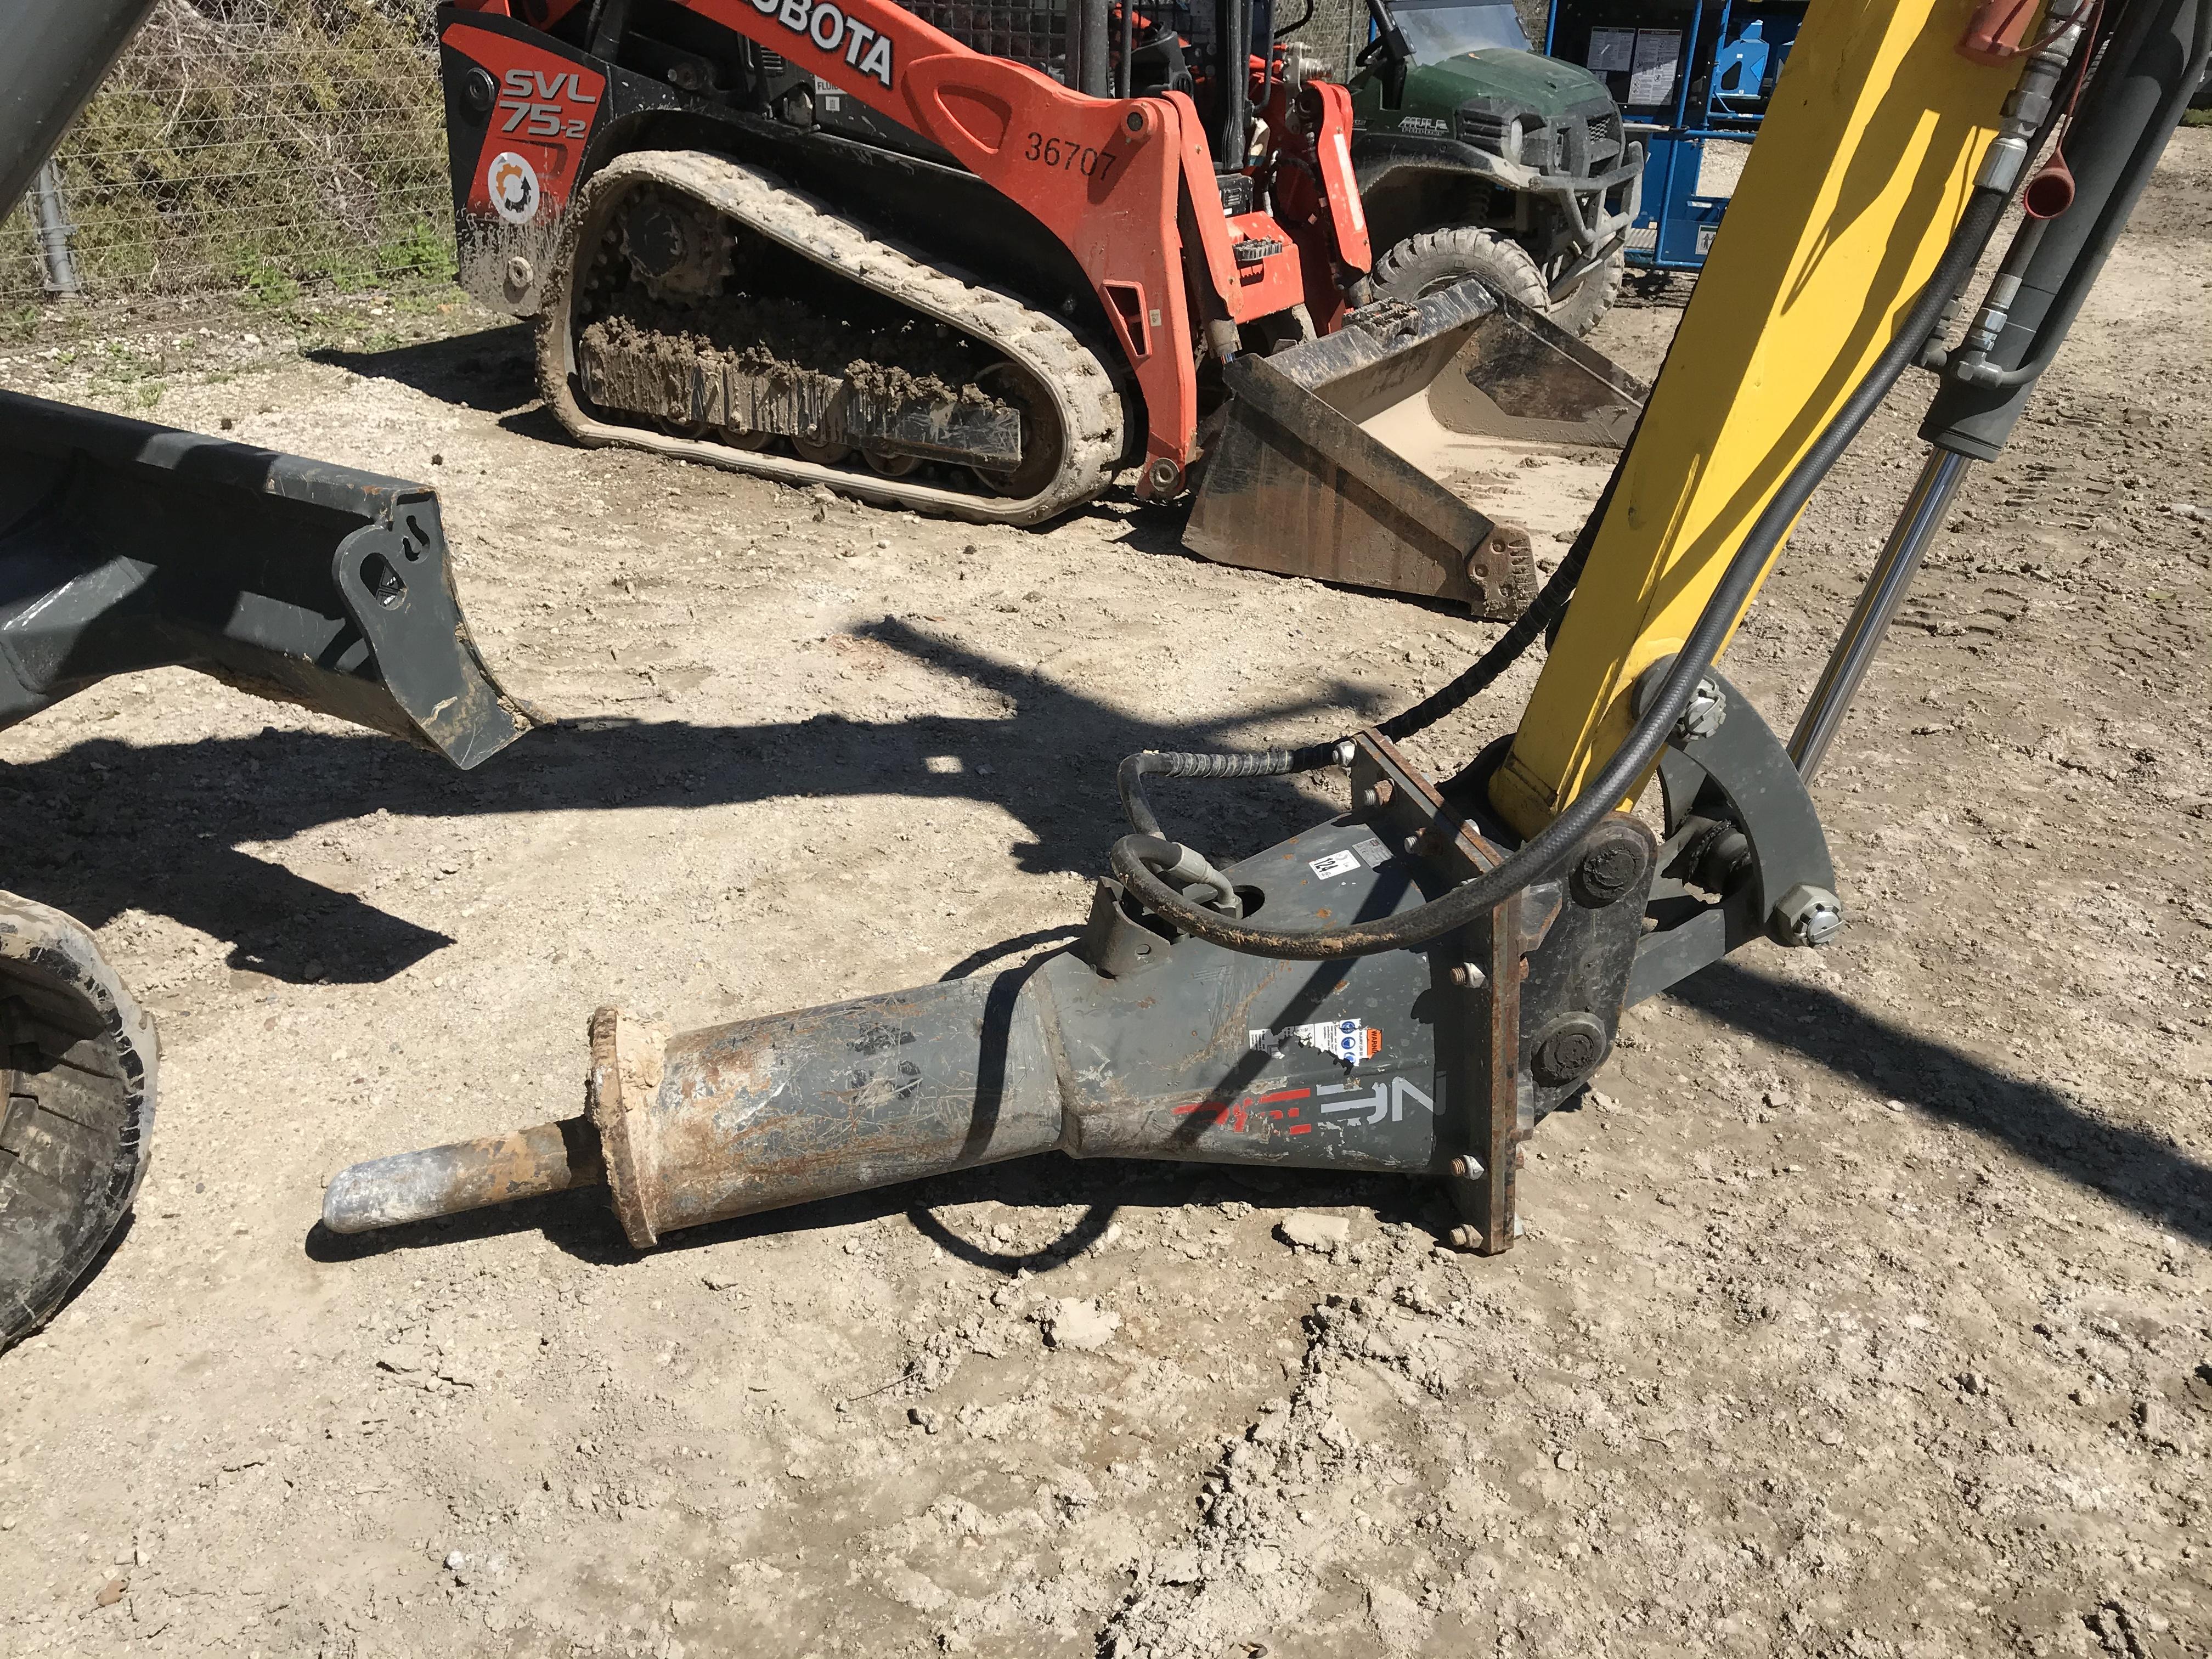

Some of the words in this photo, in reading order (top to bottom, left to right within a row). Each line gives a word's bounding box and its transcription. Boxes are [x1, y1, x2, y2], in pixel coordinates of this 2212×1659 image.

[503, 69, 596, 103] SVL
[499, 100, 586, 138] 75-2
[1025, 132, 1117, 182] 36707
[1314, 857, 1339, 872] 124
